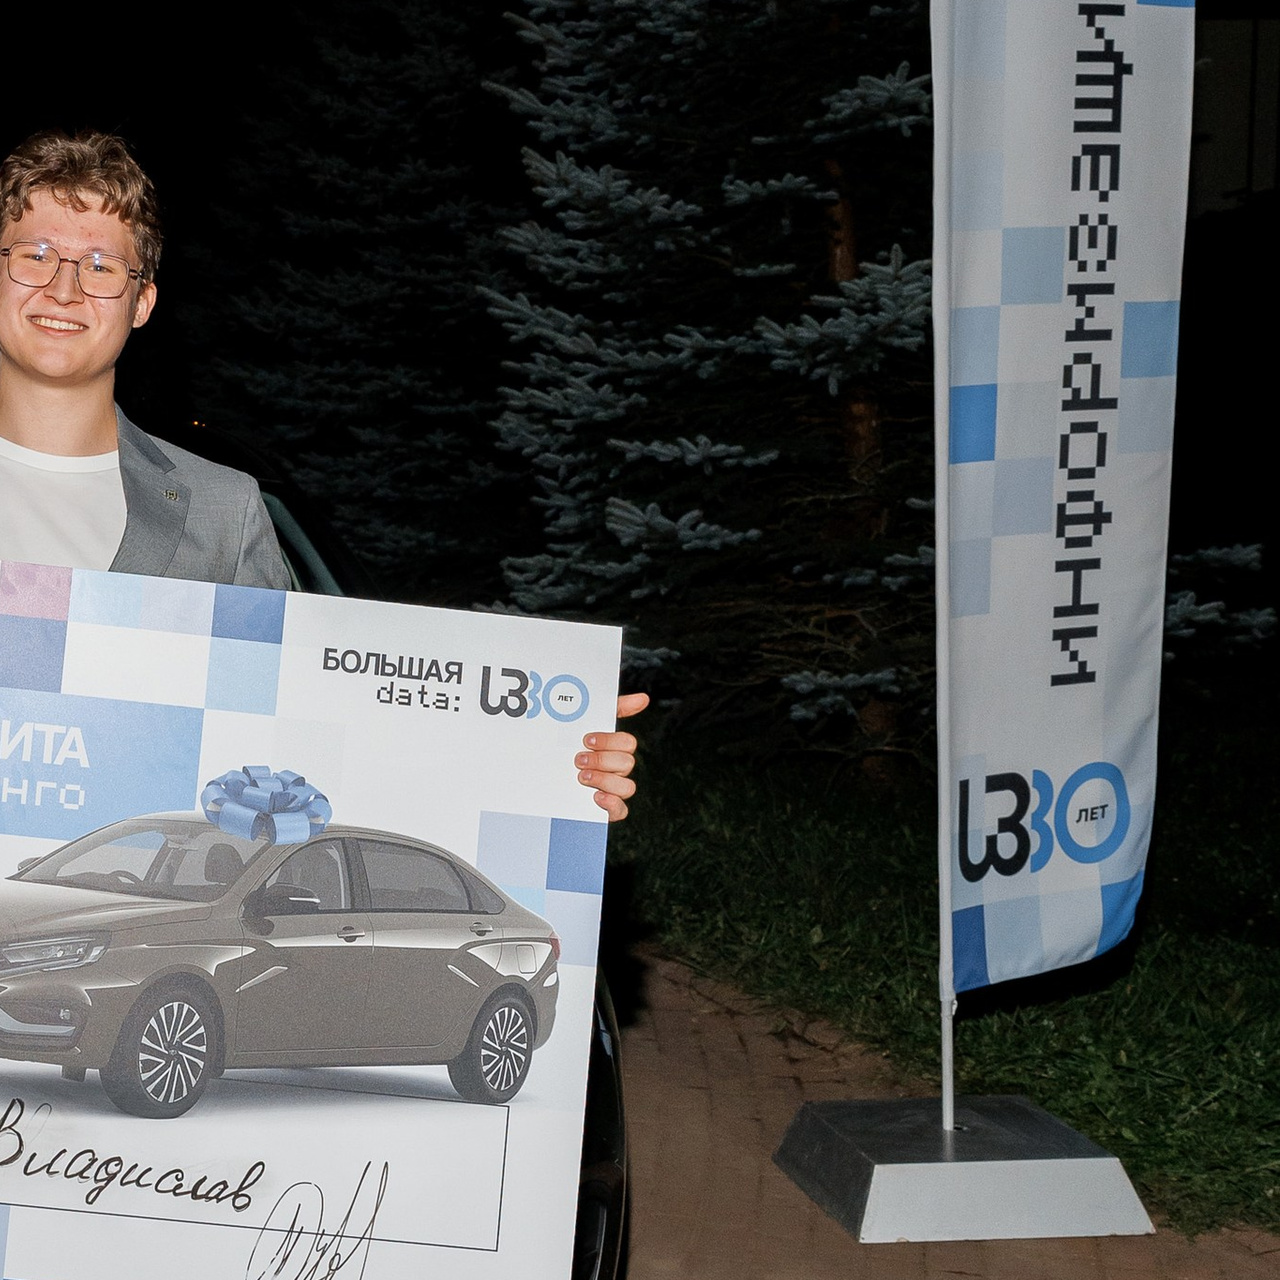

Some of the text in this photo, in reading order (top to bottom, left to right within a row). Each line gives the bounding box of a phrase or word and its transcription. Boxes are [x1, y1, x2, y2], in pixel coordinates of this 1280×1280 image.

[322, 647, 463, 684] БОЛЬШАЯ
[376, 681, 460, 712] data:
[557, 694, 574, 702] ЛЕТ
[1075, 804, 1109, 824] ЛЕТ
